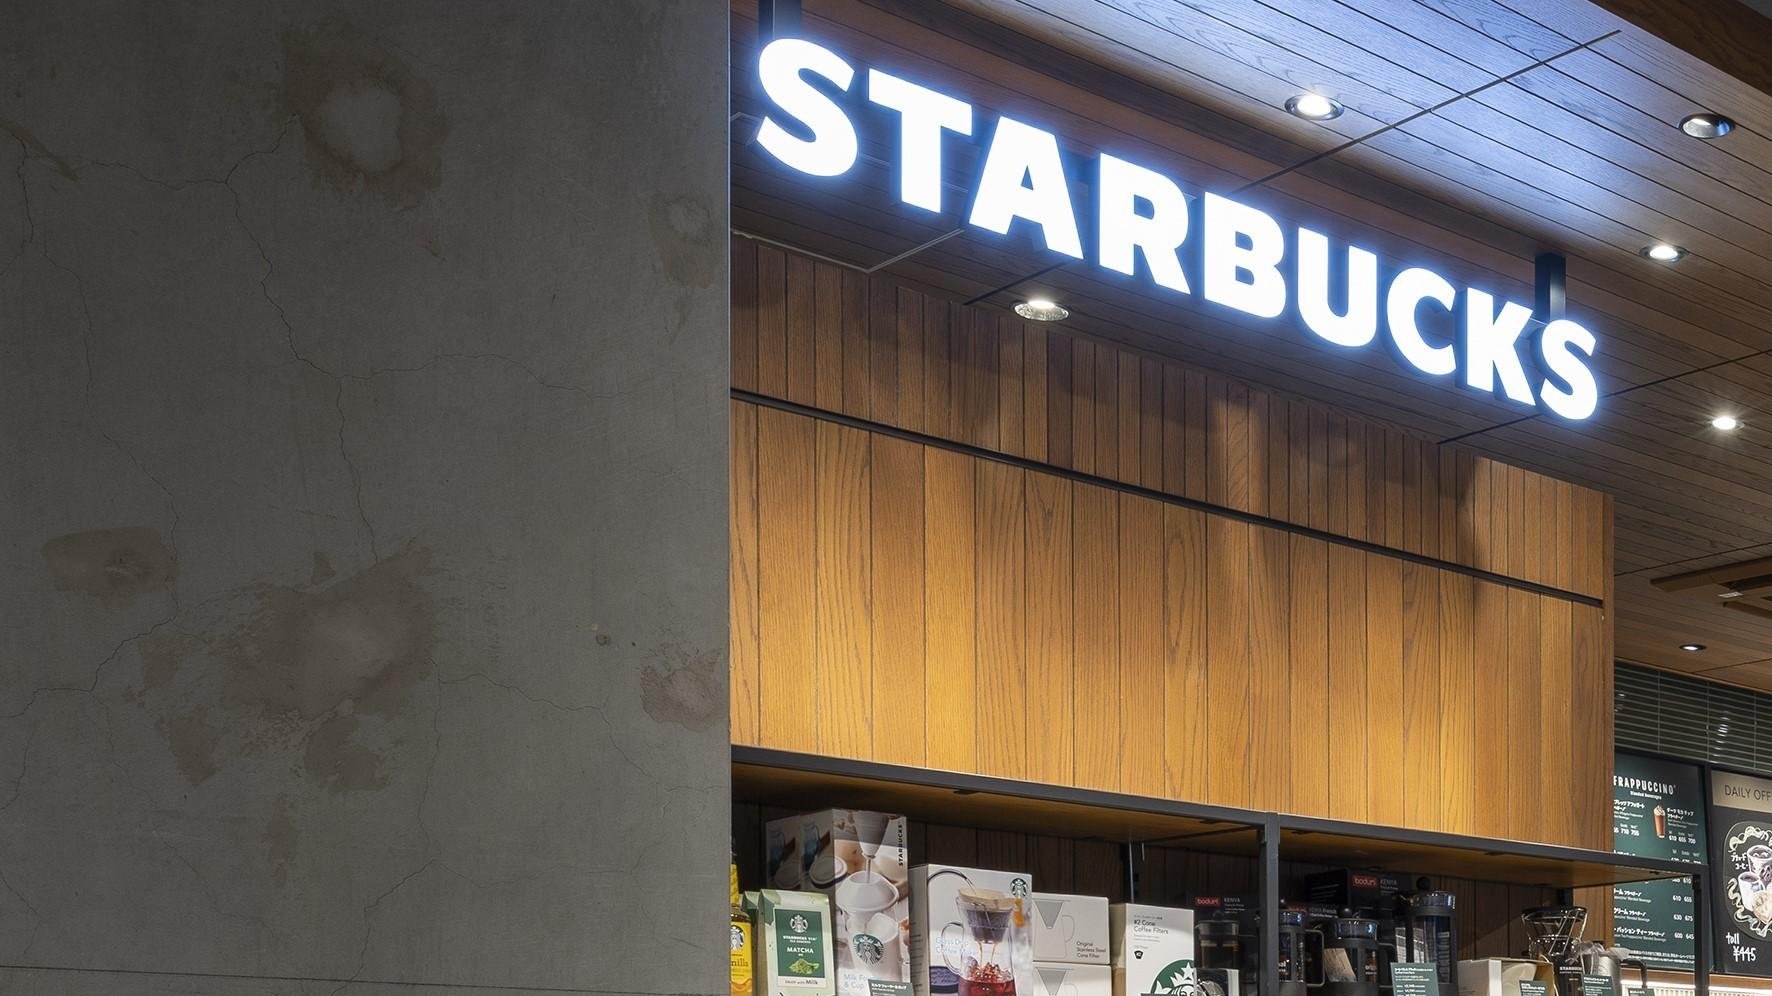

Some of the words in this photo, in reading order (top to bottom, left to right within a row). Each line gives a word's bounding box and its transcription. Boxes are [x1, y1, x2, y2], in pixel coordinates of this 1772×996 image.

[756, 37, 1600, 421] STARBUCKS
[1724, 784, 1751, 798] DAILY
[1153, 927, 1169, 935] Filters
[1076, 940, 1094, 948] Original
[787, 946, 814, 954] MATCHA
[1733, 945, 1756, 962] ¥445
